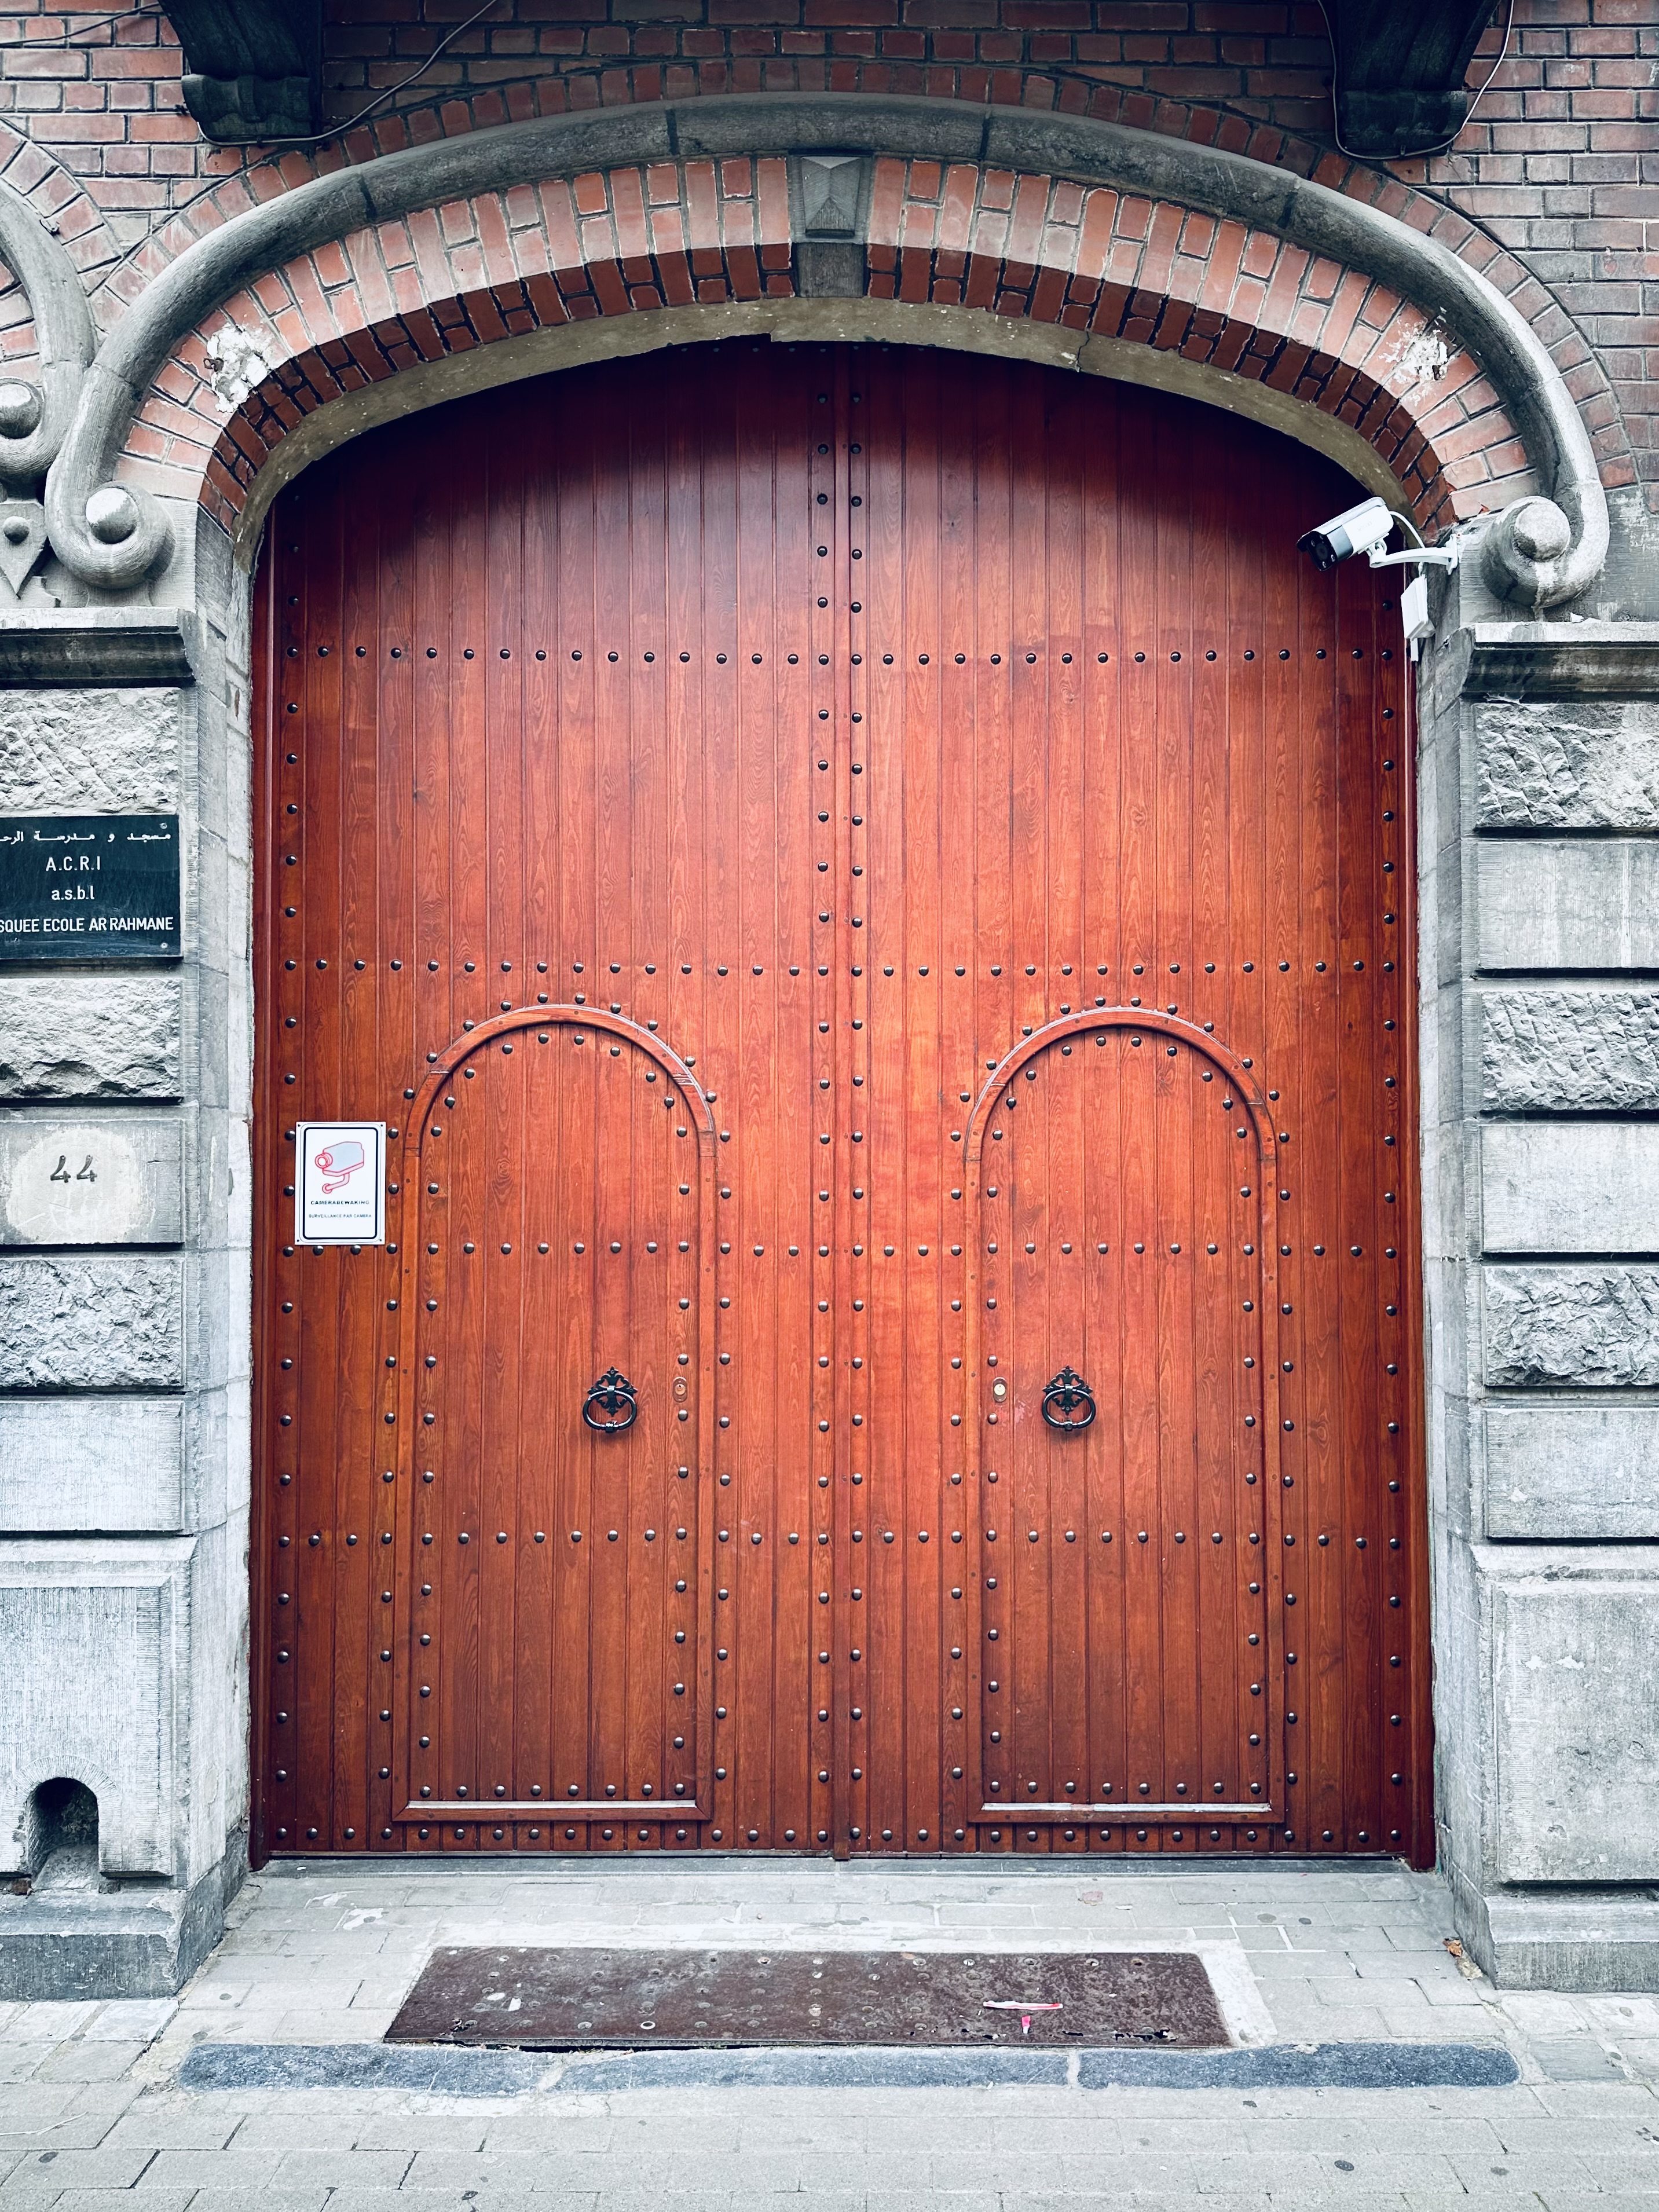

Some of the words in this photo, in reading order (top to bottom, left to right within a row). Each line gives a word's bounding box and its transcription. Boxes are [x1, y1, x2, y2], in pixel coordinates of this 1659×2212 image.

[33, 830, 96, 844] مدرسة
[107, 833, 115, 843] و
[127, 832, 171, 843] مسجد
[45, 855, 101, 871] A.C.R.I
[51, 885, 95, 900] a.s.b.l
[43, 917, 85, 932] ECOLE
[109, 916, 174, 931] RAHMANE
[50, 1154, 98, 1183] 44
